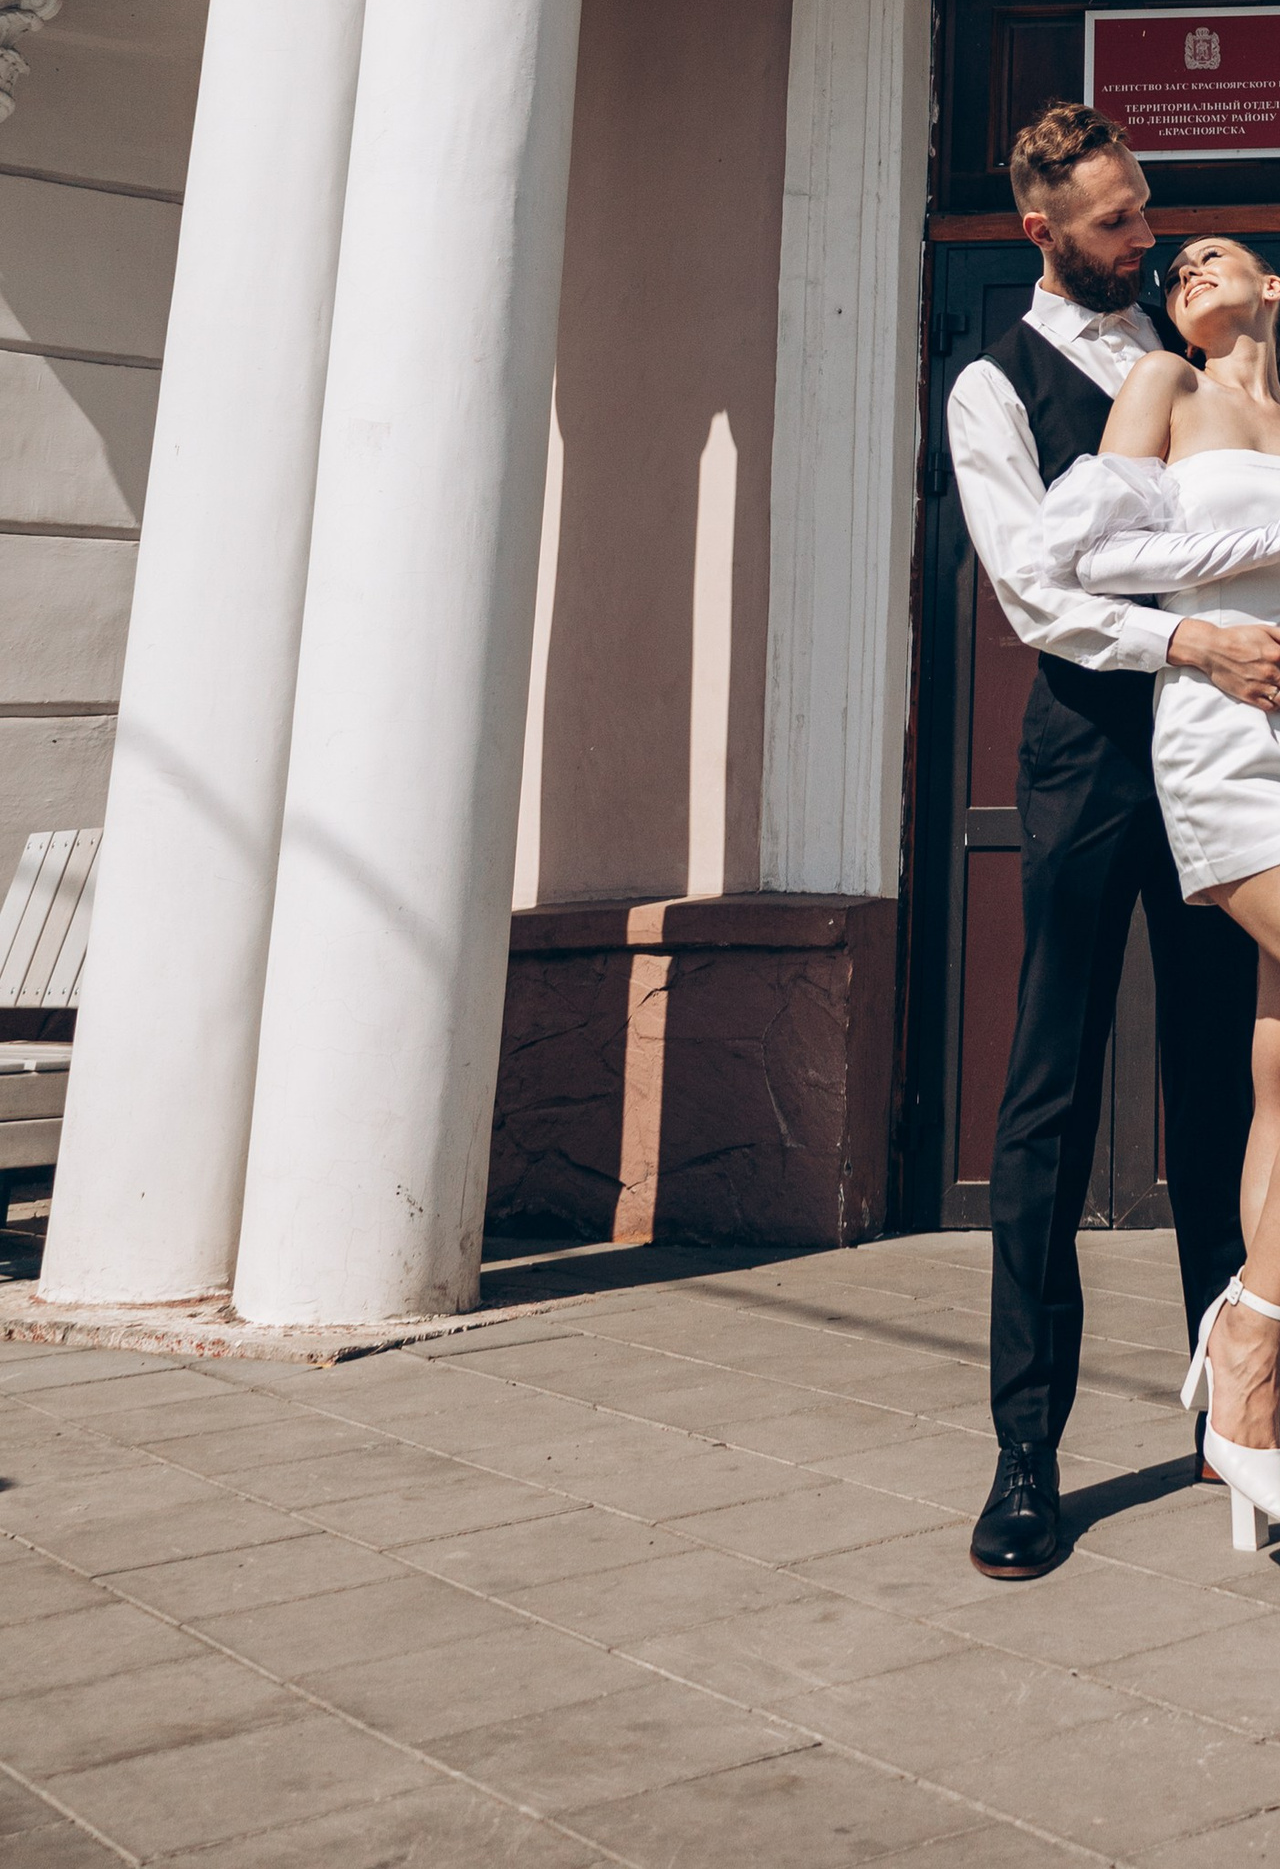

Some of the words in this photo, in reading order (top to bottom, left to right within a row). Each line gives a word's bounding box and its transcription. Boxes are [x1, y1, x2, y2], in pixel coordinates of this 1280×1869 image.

[1101, 83, 1162, 92] АГЕНТСТВО
[1164, 82, 1190, 91] ЗАГС
[1191, 80, 1276, 90] КРАСНОЯРСКОГО
[1125, 100, 1240, 113] ТЕРРИТОРИАЛЬНЫЙ
[1243, 100, 1280, 110] ОТДЕЛ
[1128, 116, 1145, 125] ПО
[1147, 114, 1228, 125] ЛЕНИНСКОМУ
[1231, 112, 1277, 122] РАЙОНУ
[1158, 126, 1246, 137] г.КРАСНОЯРСКА
